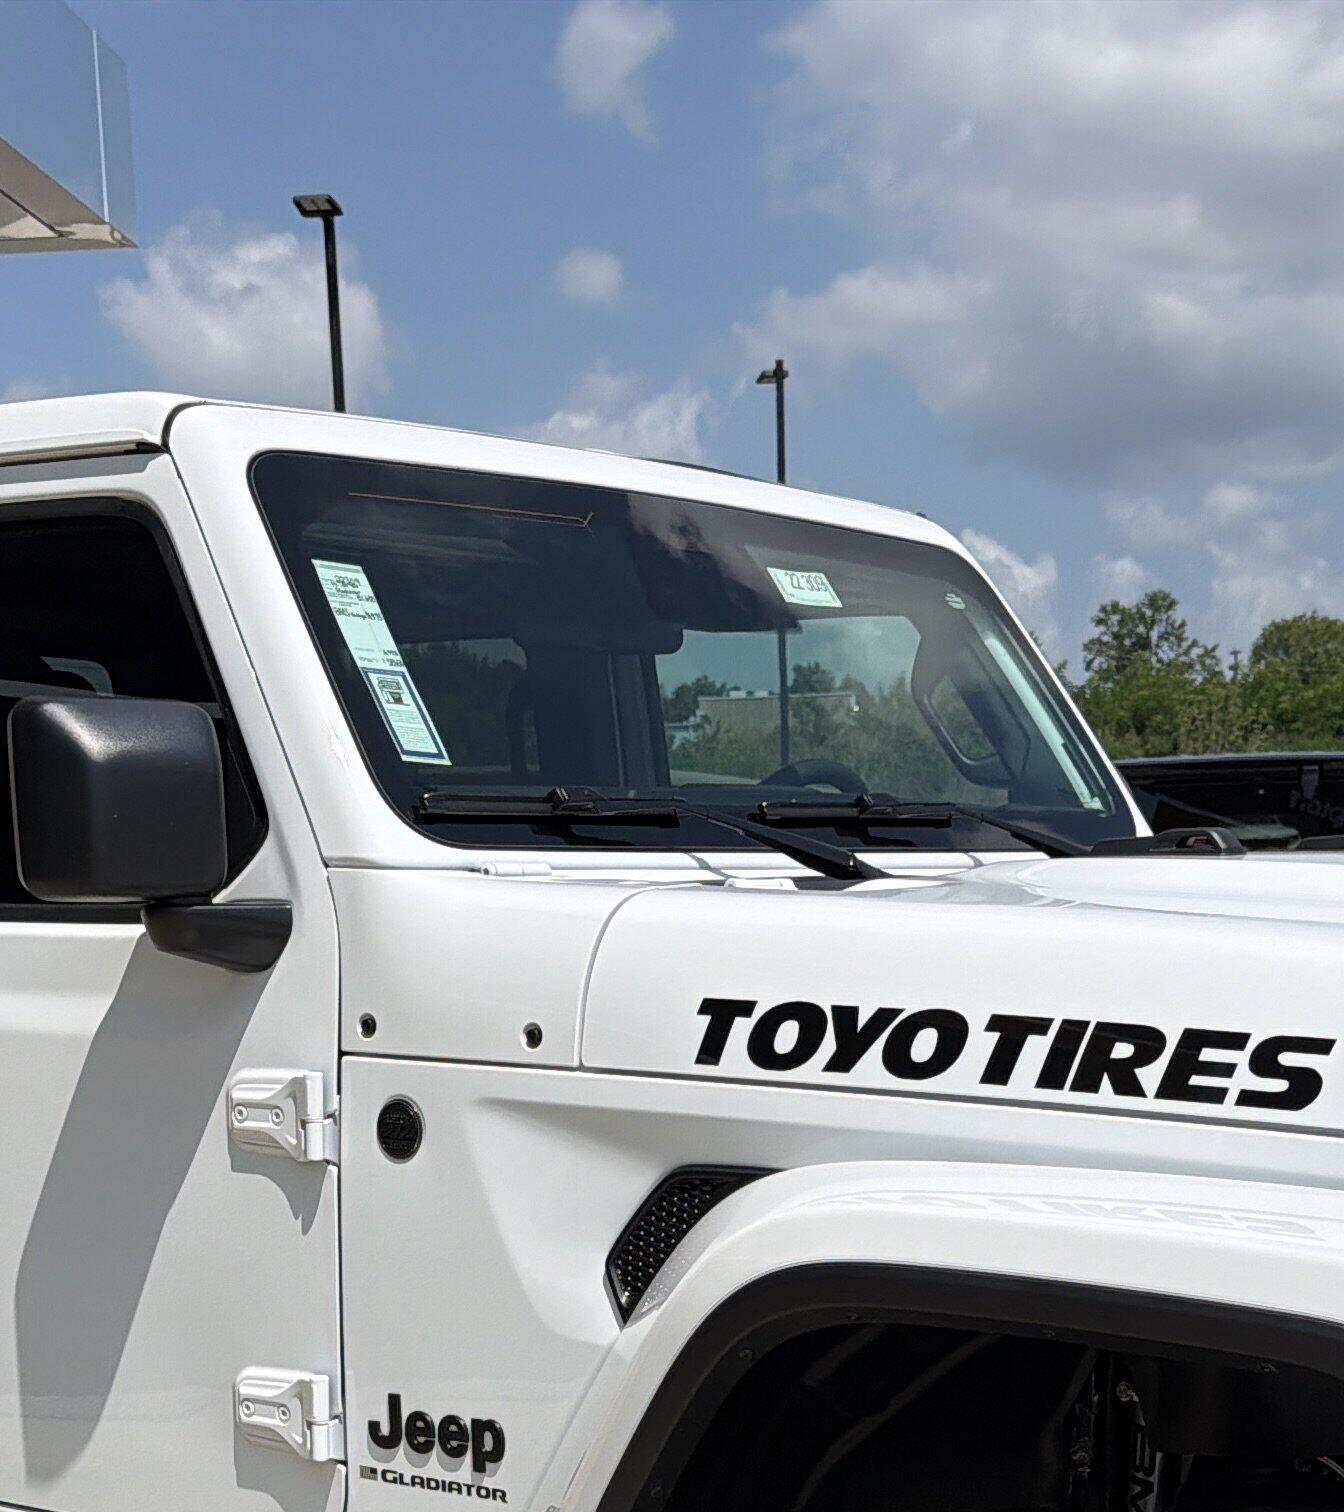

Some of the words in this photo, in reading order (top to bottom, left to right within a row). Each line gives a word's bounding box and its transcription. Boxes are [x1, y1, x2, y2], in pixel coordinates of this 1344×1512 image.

[694, 997, 969, 1080] TOYO
[980, 1013, 1337, 1112] TIRES
[368, 1393, 505, 1473] Jeep
[381, 1468, 508, 1503] GLADIATOR
